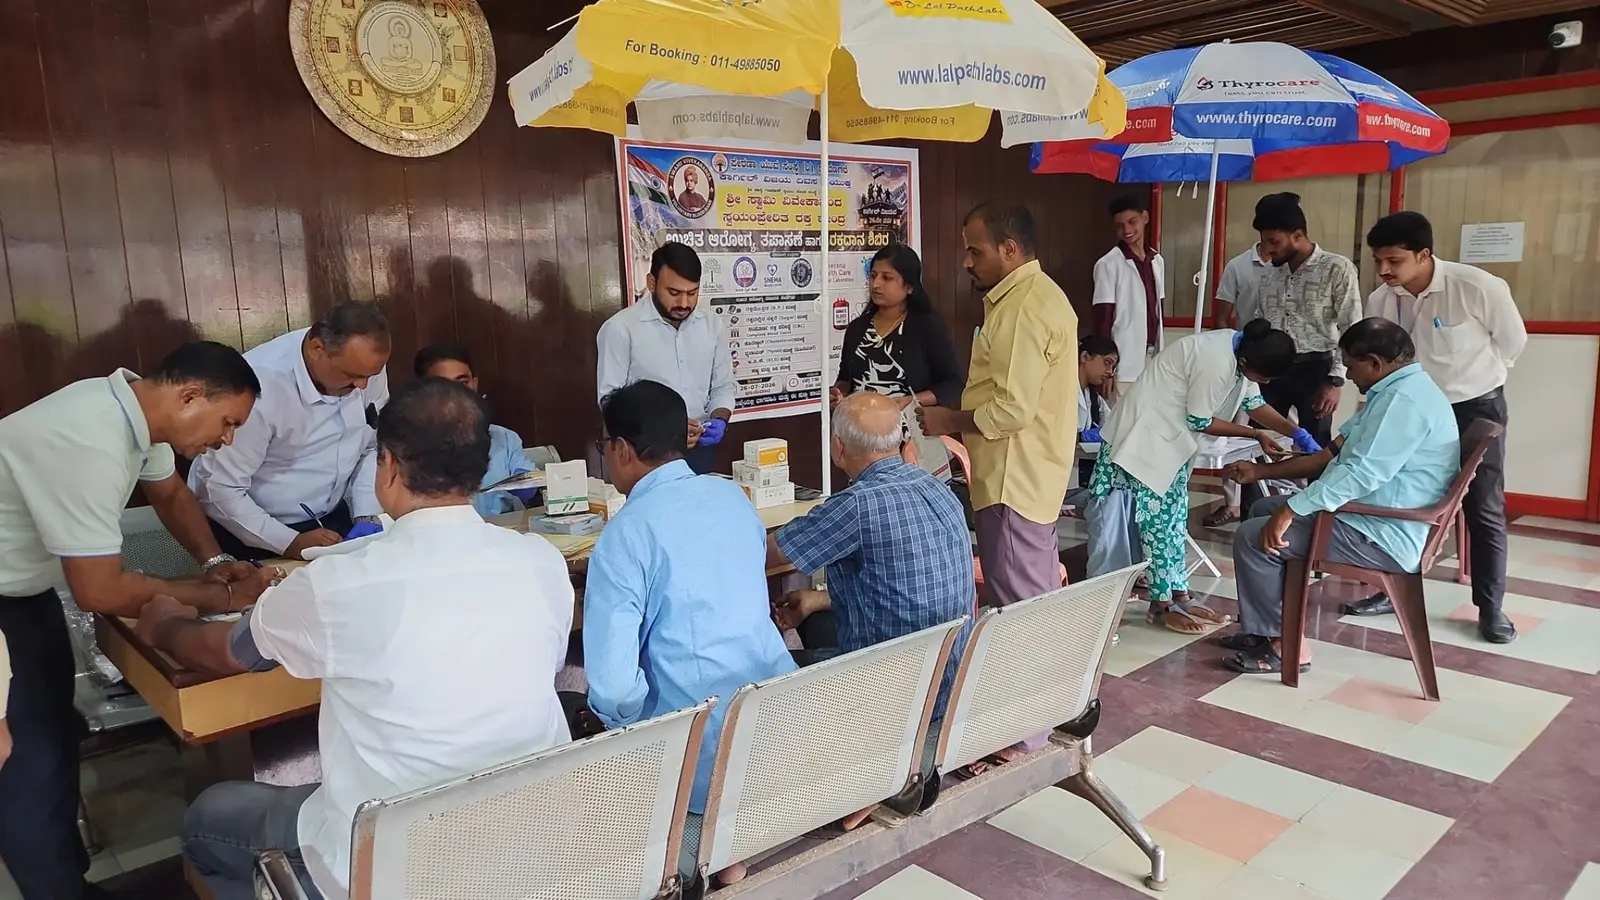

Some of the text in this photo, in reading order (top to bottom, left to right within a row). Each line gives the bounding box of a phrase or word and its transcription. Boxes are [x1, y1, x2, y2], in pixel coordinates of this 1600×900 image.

[625, 39, 646, 53] For
[649, 43, 700, 66] Booking
[710, 54, 781, 72] 011-49885050
[898, 60, 1047, 91] www.lalpathlabs.com
[1218, 79, 1320, 89] Thyrocare
[1196, 111, 1337, 127] www.thyrocare.com
[670, 160, 683, 178] SWAMI
[763, 175, 791, 184] ವಿಜಯ
[829, 178, 851, 189] ಯುಕ್ತ
[725, 193, 842, 209] ಶ್ರೀ ಸ್ವಾಮಿ ವಿವೇಕಾಂದ
[795, 213, 812, 226] ರಕ್ತ
[708, 230, 756, 253] ಆರೋಗ್ಯ
[760, 231, 803, 247] ತಪಾಸಣೆ
[829, 232, 865, 251] ರಕ್ತದಾನ
[868, 229, 889, 246] ಶಿಬಿರ
[740, 382, 776, 391] 26-07-2026
